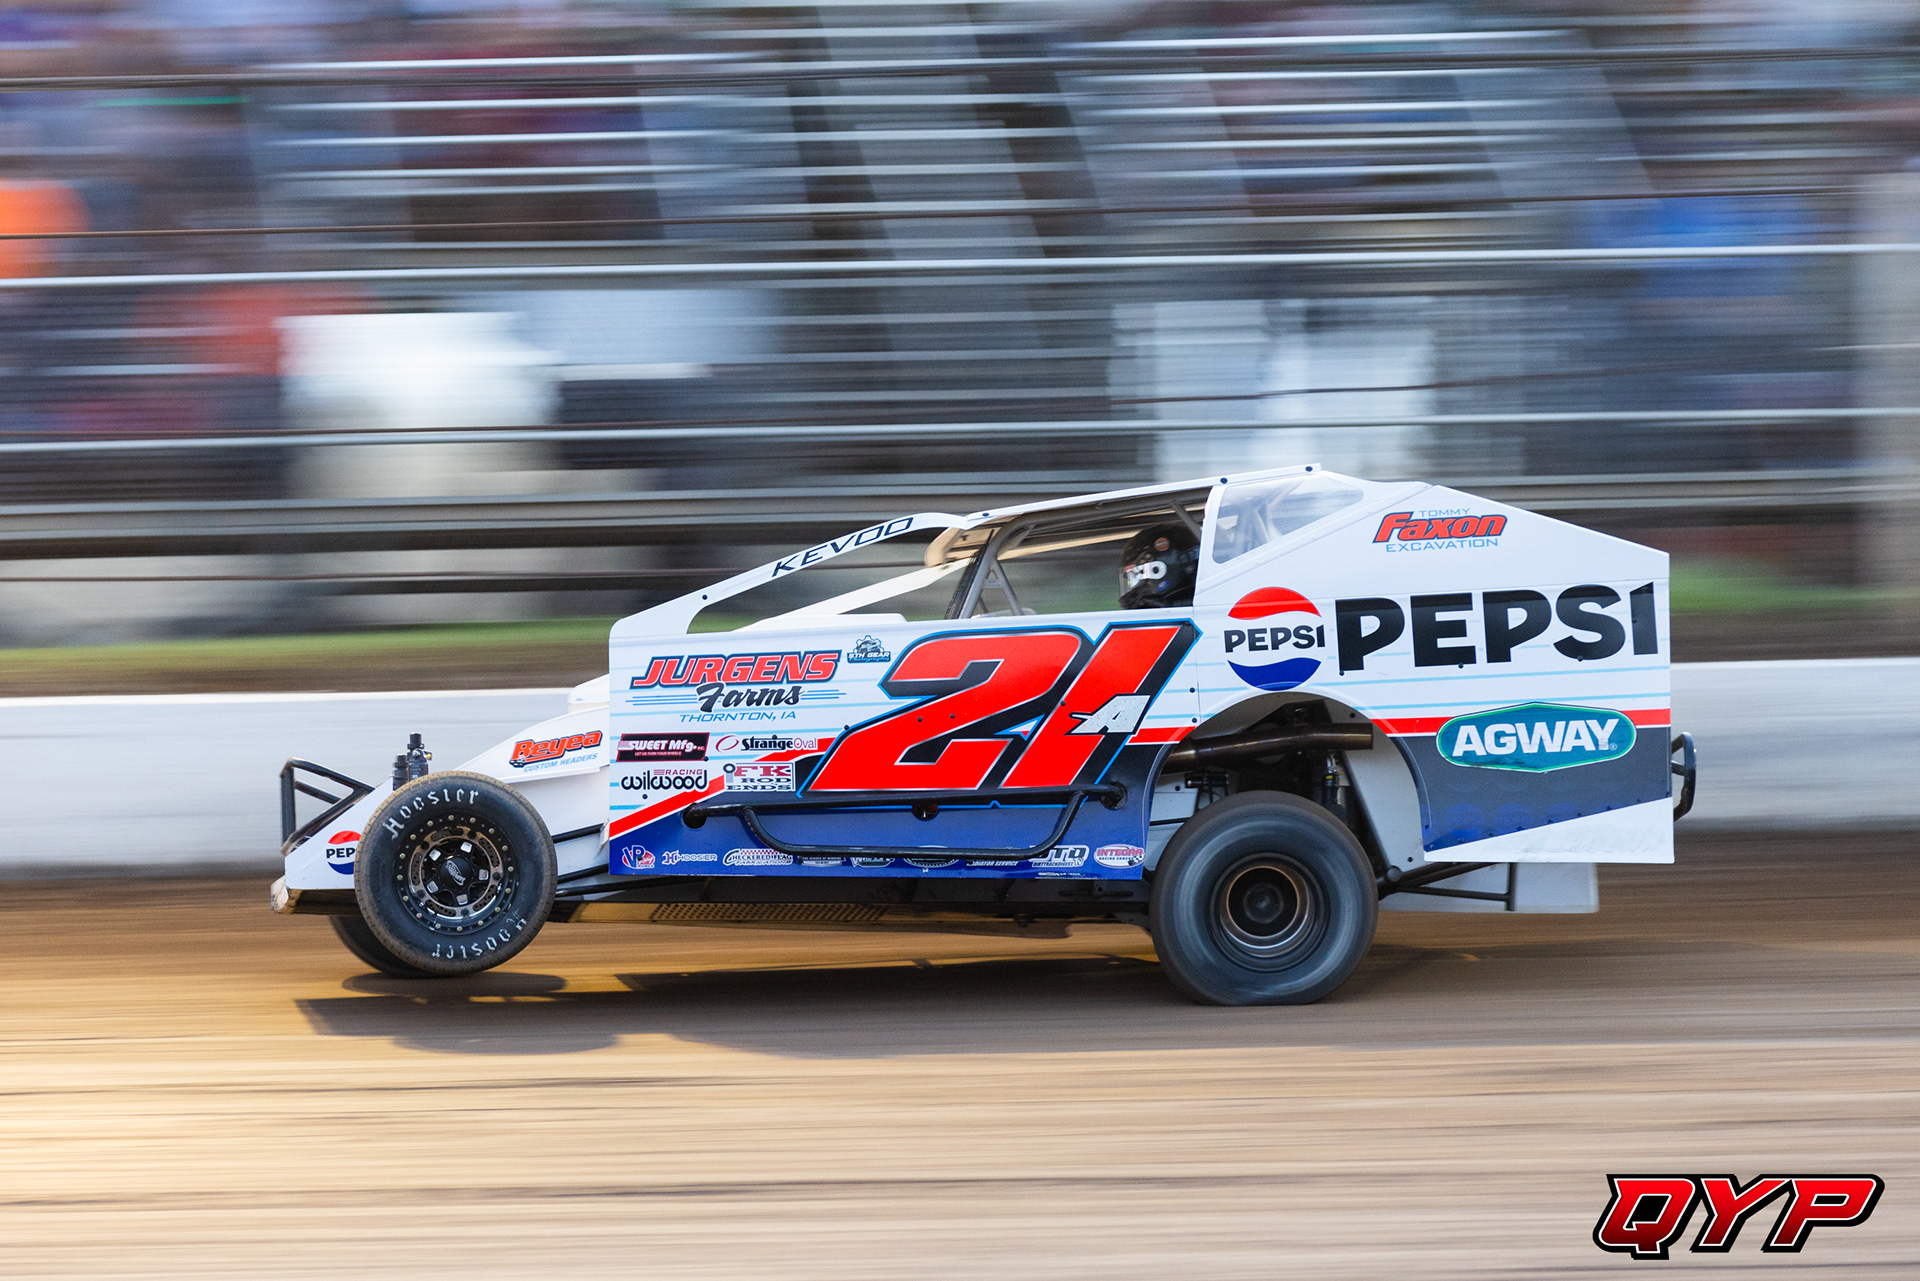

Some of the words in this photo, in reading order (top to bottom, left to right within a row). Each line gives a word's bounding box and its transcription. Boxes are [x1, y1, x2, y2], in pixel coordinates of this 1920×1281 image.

[1418, 508, 1471, 517] TOMMY
[1372, 511, 1508, 543] Faxon
[1386, 538, 1499, 552] EXCAVATION
[1334, 581, 1659, 671] PEPSI
[1224, 623, 1326, 653] PEPSI
[631, 651, 841, 688] JURGENS
[696, 682, 804, 713] Farms
[679, 712, 777, 723] THORNTON,
[780, 711, 796, 720] IA
[510, 730, 603, 764] Beyea
[618, 740, 668, 751] SWEET
[1452, 718, 1620, 757] AGWAY
[523, 760, 558, 773] CUSTOM
[560, 753, 599, 766] HEADERS
[734, 765, 792, 777] FK
[621, 769, 708, 790] wilwood
[326, 847, 356, 859] PEP
[622, 845, 646, 869] VP
[723, 850, 770, 865] CHECKERED
[1096, 848, 1144, 856] INTEGRA
